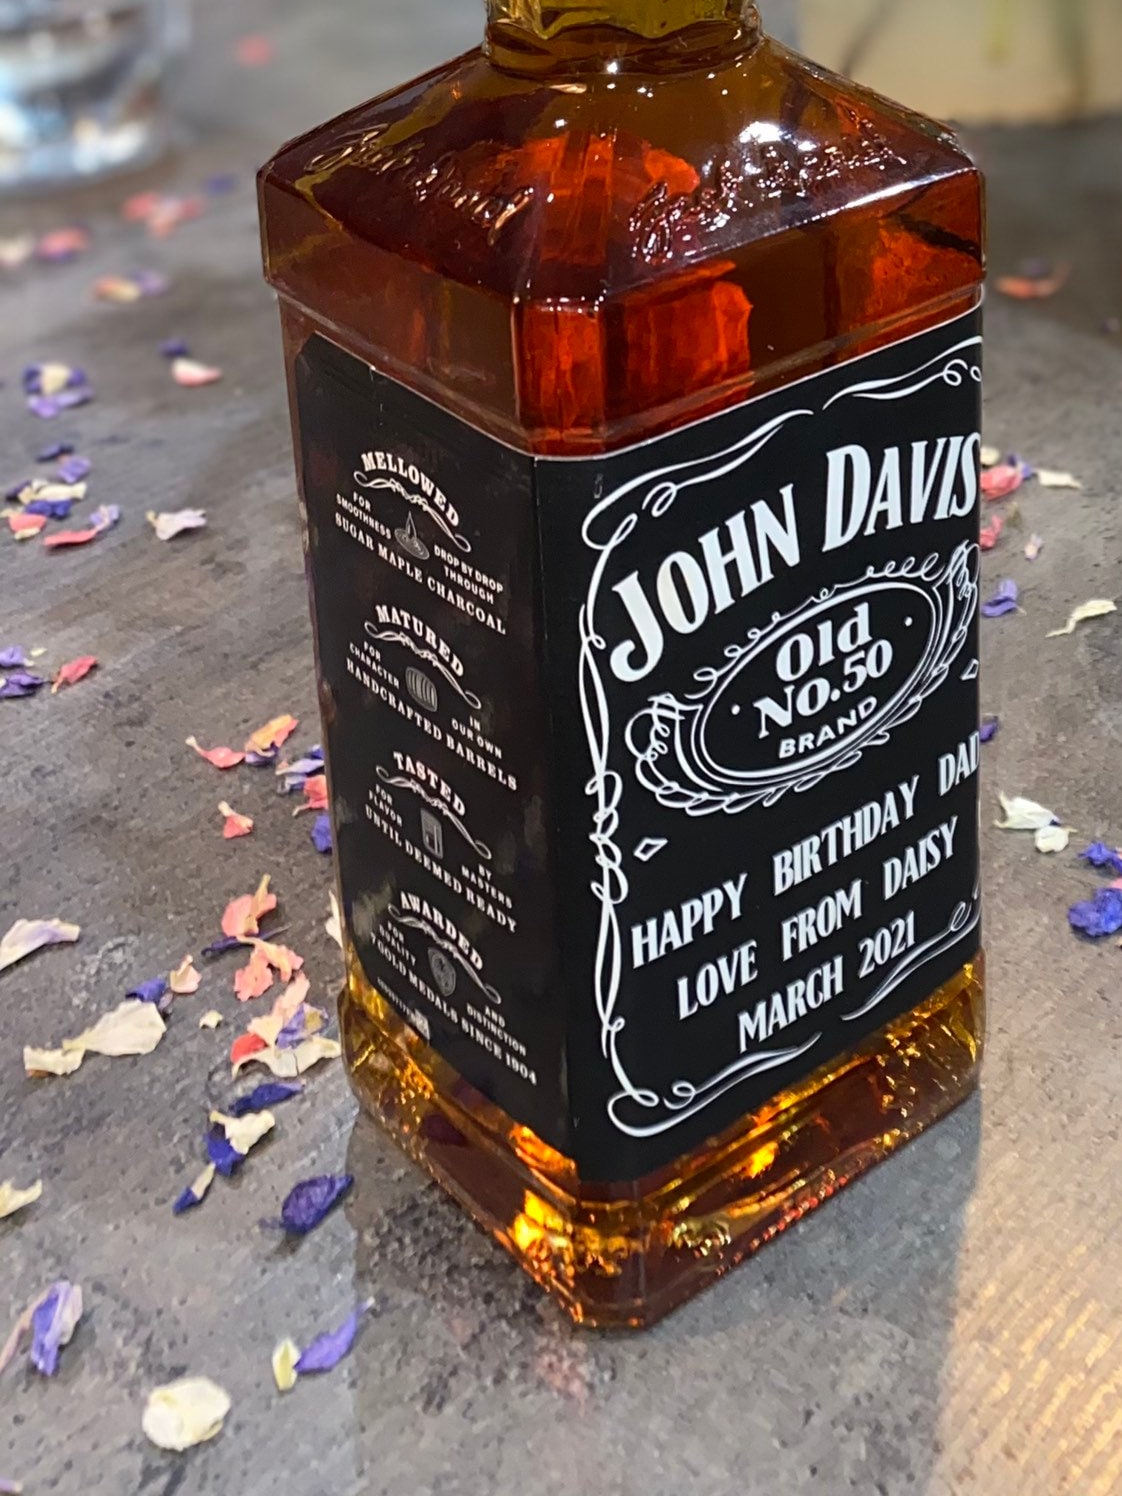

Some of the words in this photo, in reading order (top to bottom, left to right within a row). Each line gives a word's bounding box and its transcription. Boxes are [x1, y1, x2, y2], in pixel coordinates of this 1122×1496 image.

[336, 493, 391, 540] SMOOTHNESS
[353, 491, 371, 512] FOR
[361, 451, 459, 527] MELLOWED
[335, 512, 374, 551] SUGAR
[378, 543, 423, 584] MAPLE
[427, 576, 506, 635] CHARCOAL
[434, 544, 460, 567] DROP
[461, 562, 473, 578] BY
[475, 569, 503, 593] DROP
[444, 565, 494, 604] THROUGH
[610, 484, 801, 682] JOHN
[822, 433, 981, 553] DAVIS
[350, 642, 399, 689] CHARACTER
[364, 640, 381, 662] FOR
[375, 604, 464, 677] MATURED
[776, 602, 873, 682] Old
[752, 639, 893, 739] No.50
[347, 657, 442, 740] HANDCRAFTED
[446, 733, 516, 791] BARRELS
[451, 717, 473, 741] OUR
[477, 735, 502, 759] OWN
[469, 714, 480, 732] IN
[779, 696, 877, 759] BRAND
[368, 789, 402, 827] FLAVOR
[376, 784, 393, 805] FOR
[393, 751, 466, 816] TASTED
[365, 803, 402, 847] UNTIL
[405, 838, 462, 894] DEEMED
[466, 886, 517, 933] READY
[479, 864, 492, 881] BY
[630, 873, 748, 970] HAPPY
[772, 774, 920, 897] BIRTHDAY
[937, 730, 980, 798] DAD
[461, 864, 512, 909] MASTERS
[379, 924, 416, 967] QUALITY
[401, 890, 483, 971] AWARDED
[676, 939, 758, 1020] LOVE
[781, 878, 863, 962] FROM
[883, 816, 959, 900] DAISY
[738, 955, 844, 1054] MARCH
[858, 910, 916, 979] 2021
[377, 938, 407, 977] GOLD
[408, 968, 458, 1024] MEDALS
[461, 1016, 502, 1060] SINCE
[506, 1052, 538, 1086] 1904
[466, 1002, 527, 1057] DISTINCTION
[485, 1005, 506, 1029] AND
